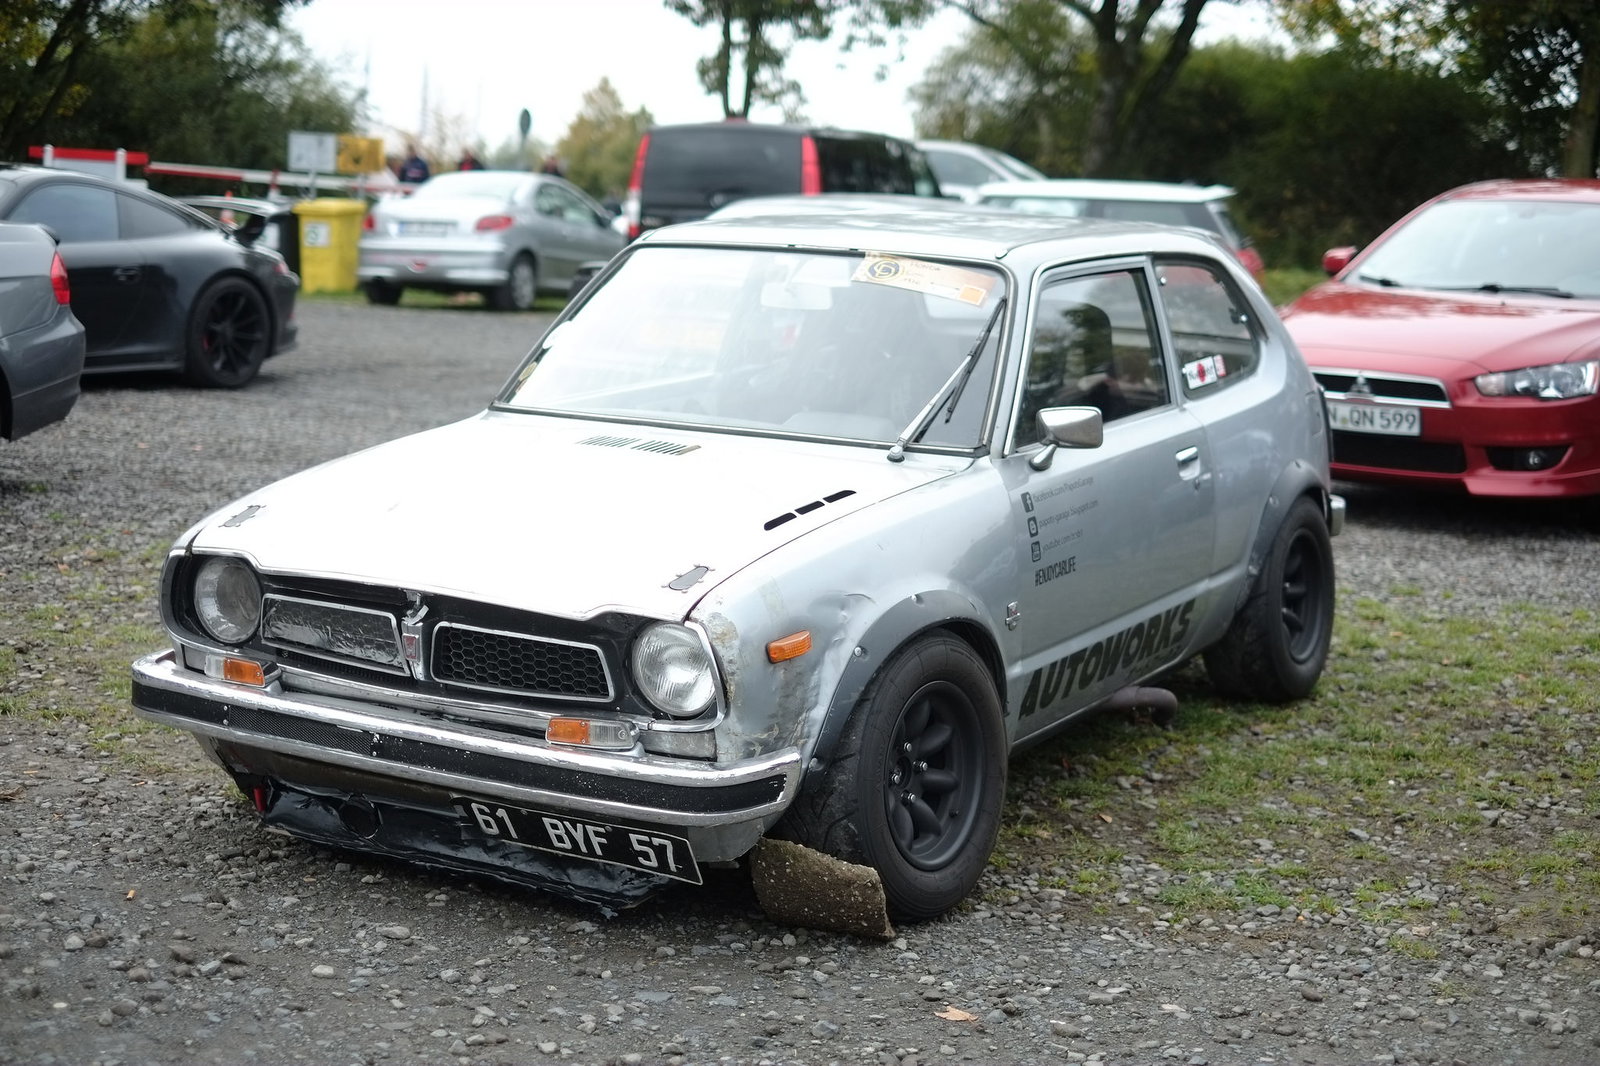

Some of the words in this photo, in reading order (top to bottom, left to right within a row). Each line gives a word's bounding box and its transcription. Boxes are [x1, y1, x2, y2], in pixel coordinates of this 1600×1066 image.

[1350, 408, 1375, 428] QN
[1379, 411, 1416, 431] 599
[1034, 555, 1076, 587] #ENJOYCARLIFE
[1018, 598, 1196, 720] AUTOWORKS
[470, 802, 519, 840] 61
[541, 816, 609, 857] BYF
[628, 832, 683, 873] 57
